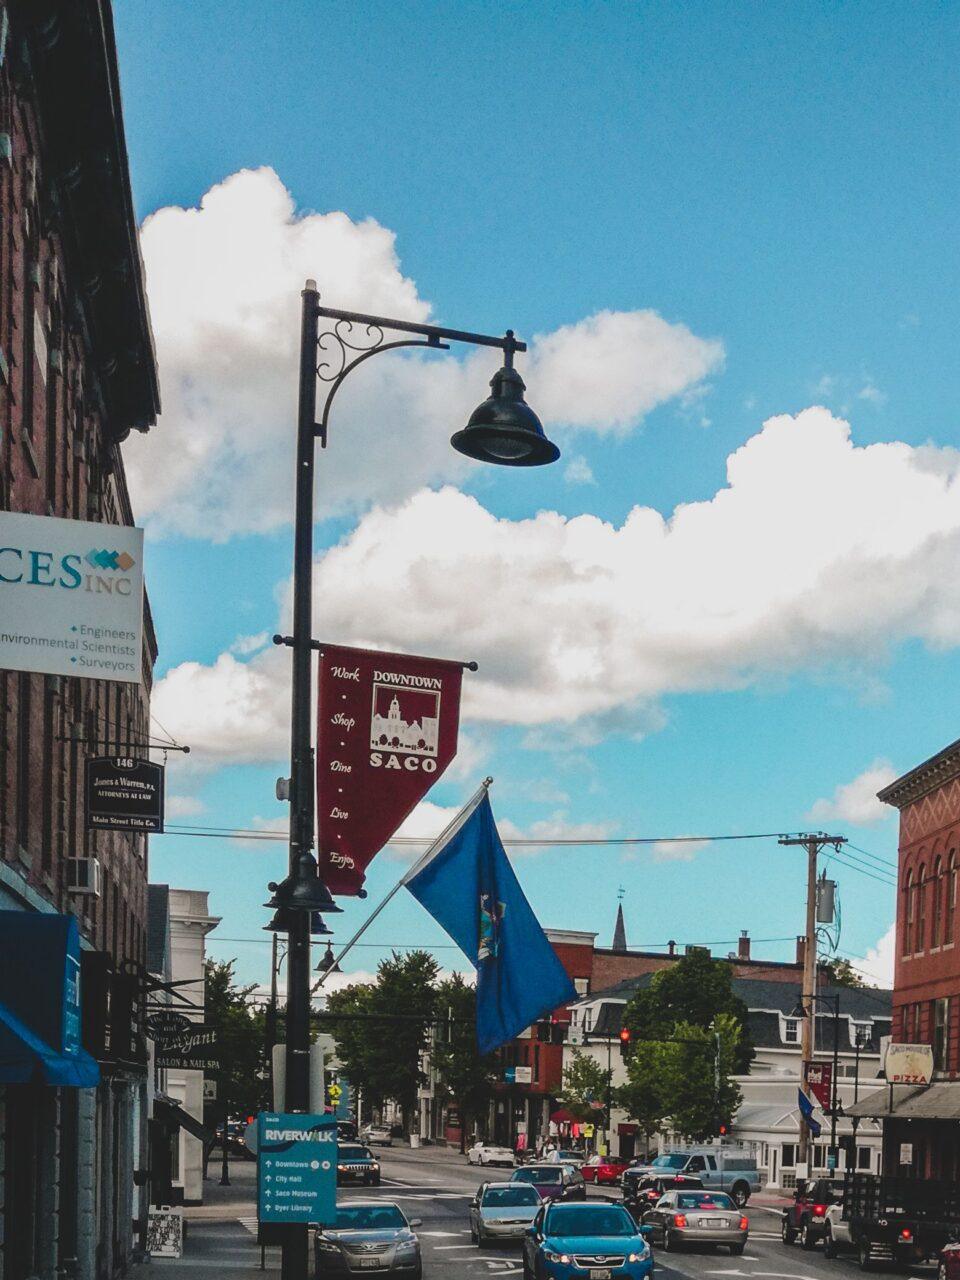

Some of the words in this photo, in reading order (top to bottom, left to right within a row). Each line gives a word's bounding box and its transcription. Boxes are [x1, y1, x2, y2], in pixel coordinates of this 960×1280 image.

[0, 547, 82, 589] CES
[85, 574, 132, 596] INC
[80, 624, 136, 641] Engineers
[1, 633, 78, 649] nvironmental
[82, 641, 136, 656] Scientists
[79, 656, 136, 672] Surveyors
[330, 666, 360, 682] Work
[373, 670, 443, 689] DOWNTOWN
[330, 713, 355, 732] Shop
[116, 758, 133, 768] 146
[330, 760, 352, 773] Dine
[369, 752, 437, 773] SACO
[98, 790, 130, 799] ATTORNEYS
[329, 806, 349, 819] Live
[92, 816, 109, 824] Main
[110, 817, 129, 825] Street
[329, 851, 355, 870] Enjoy
[156, 1058, 180, 1067] SALON
[190, 1059, 206, 1068] NAIL
[207, 1060, 220, 1070] SPA
[893, 1074, 928, 1084] PIZZA
[265, 1130, 334, 1142] RIVERWALK
[275, 1176, 287, 1184] City
[291, 1204, 312, 1212] Library
